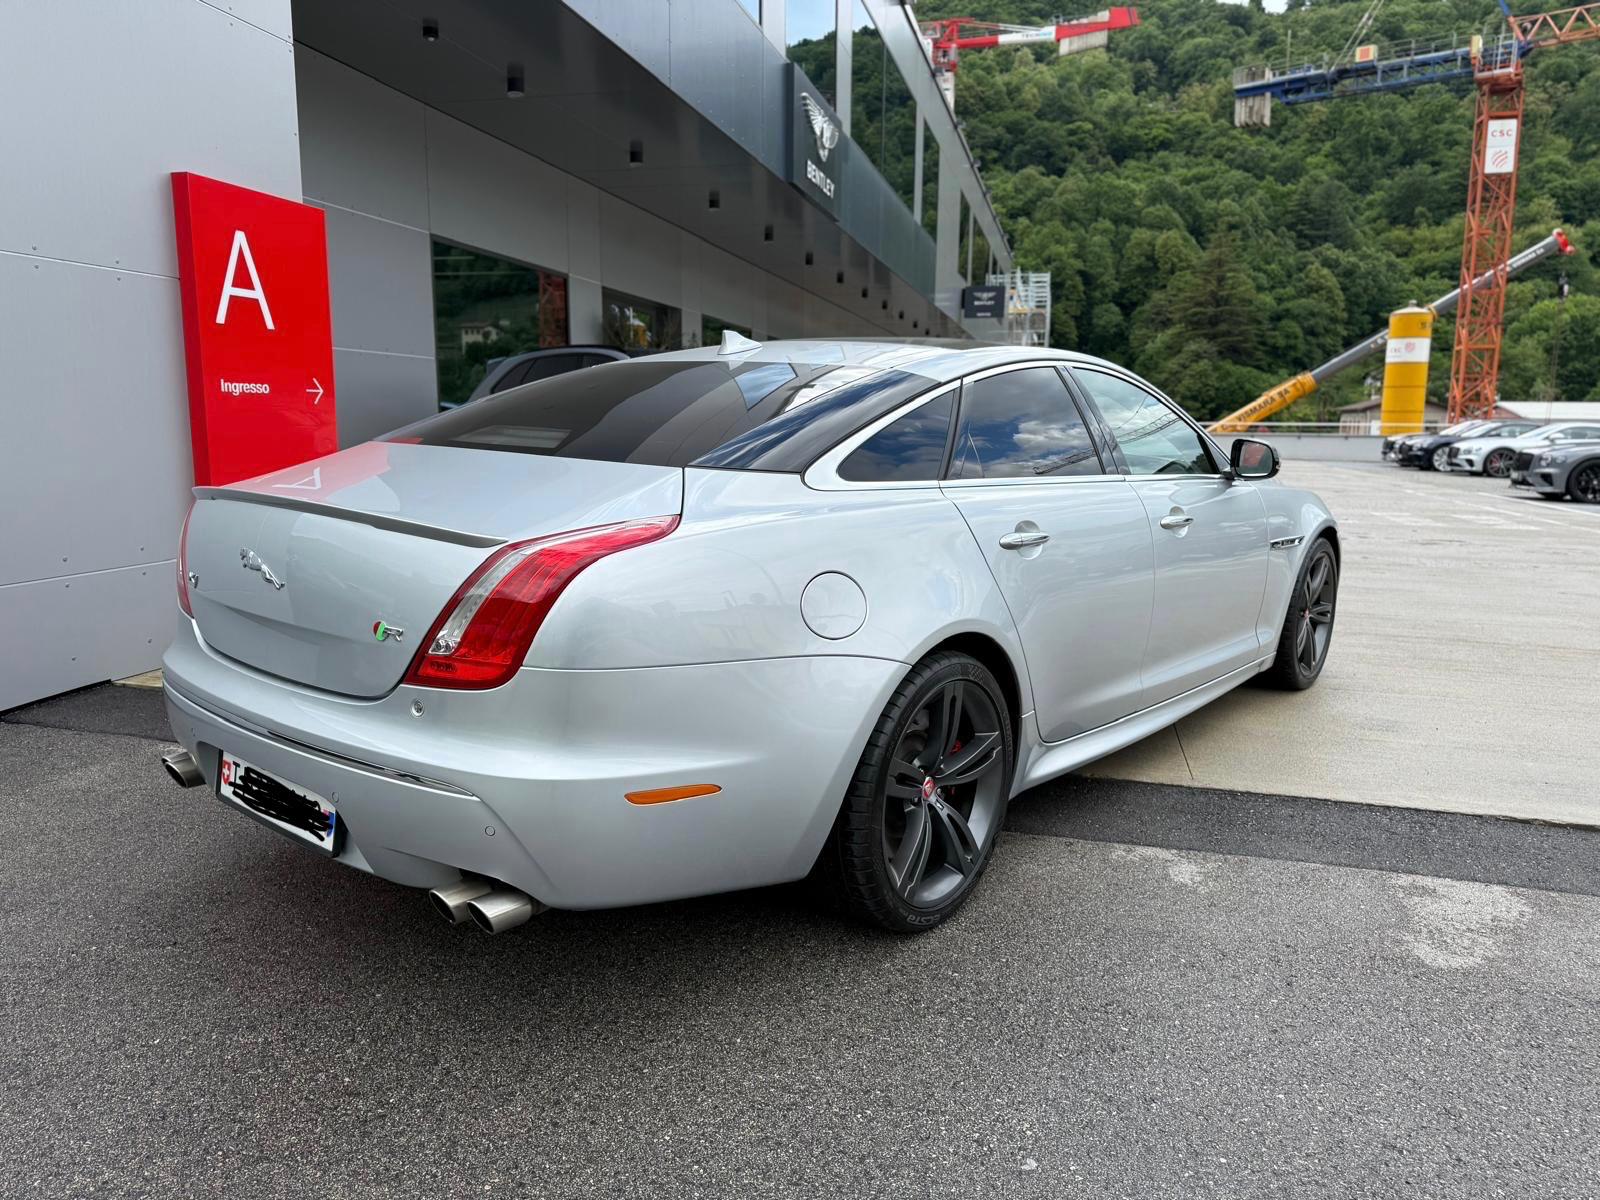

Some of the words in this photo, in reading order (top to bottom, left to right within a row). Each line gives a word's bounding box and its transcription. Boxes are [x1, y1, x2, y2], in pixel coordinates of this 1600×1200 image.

[807, 159, 834, 199] BENTLEY
[216, 230, 275, 330] A
[220, 378, 270, 396] Ingresso
[1238, 396, 1276, 422] VISMARA
